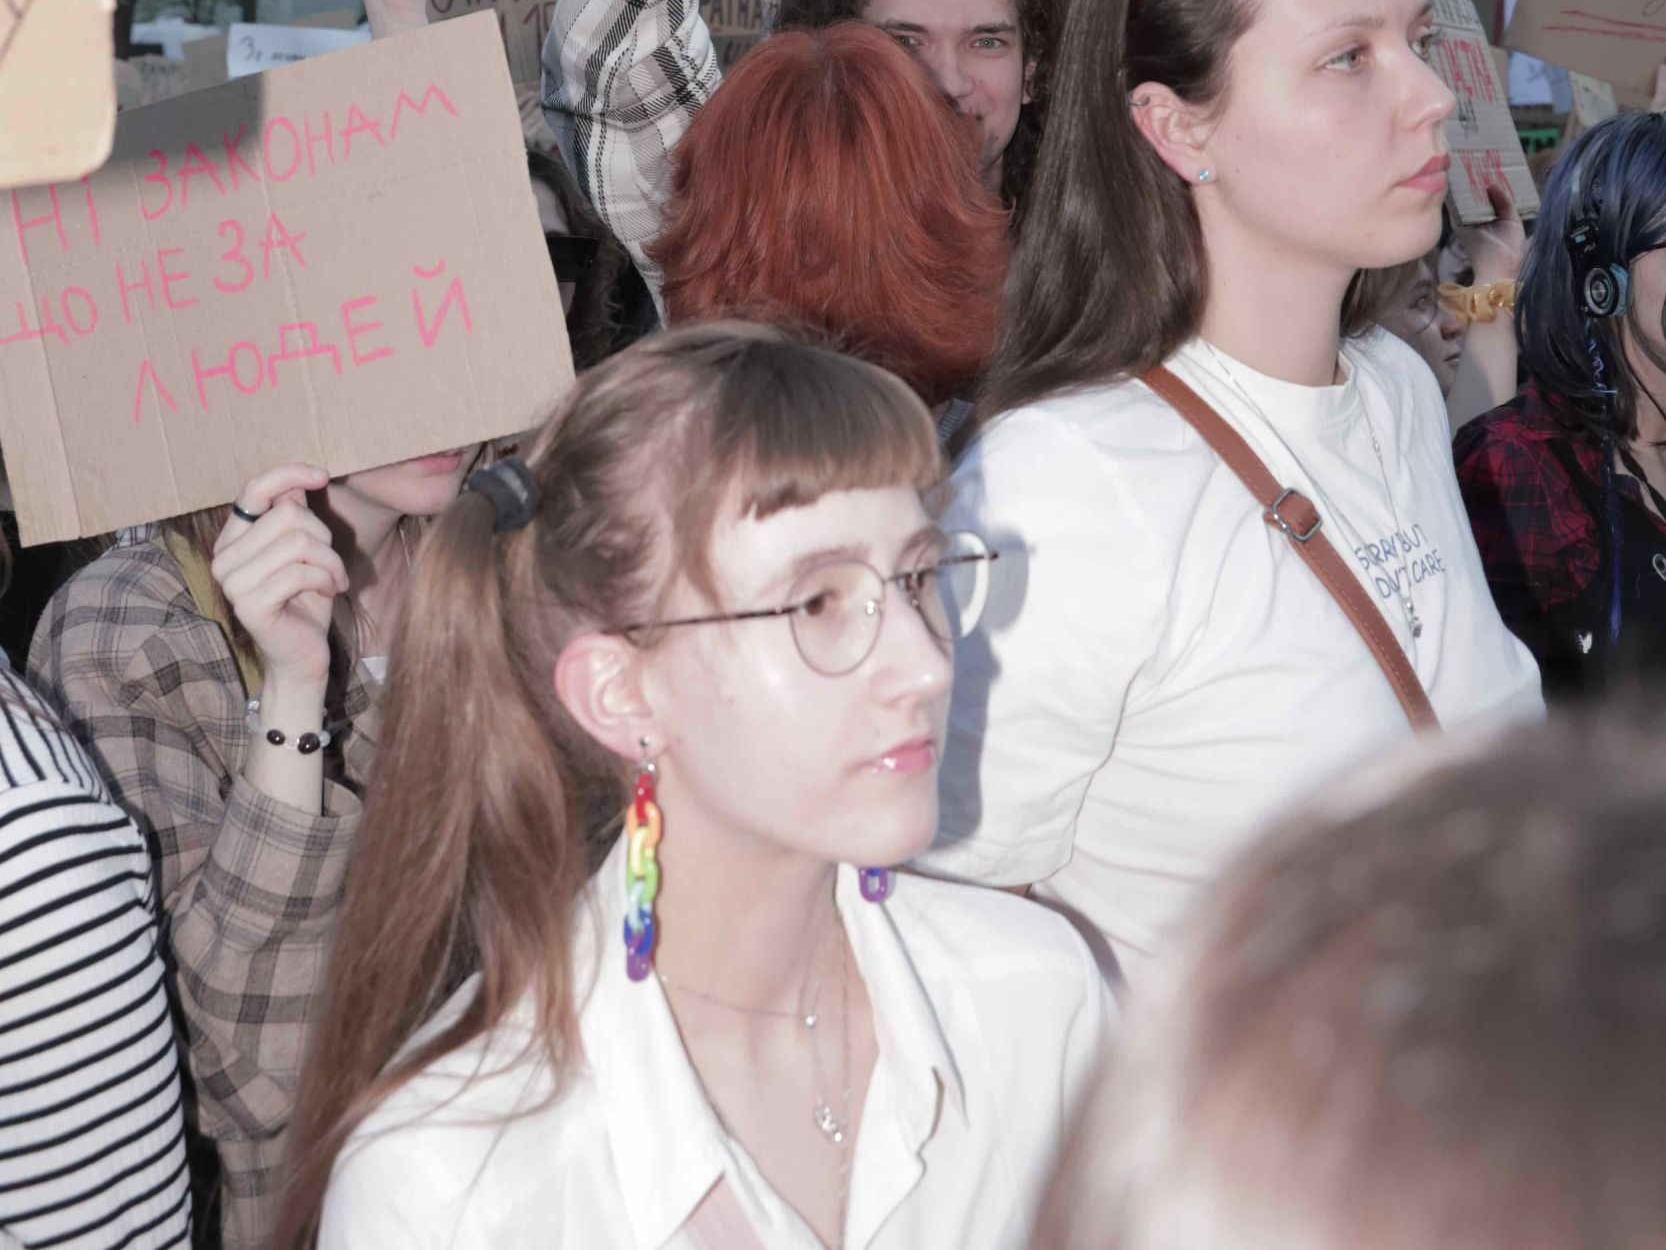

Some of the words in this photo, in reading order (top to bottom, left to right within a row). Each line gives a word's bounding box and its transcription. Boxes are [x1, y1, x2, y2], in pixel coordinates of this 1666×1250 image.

[9, 174, 102, 265] НІ
[139, 84, 459, 221] ЗАКОНАМ
[115, 247, 200, 324] НЕ
[212, 211, 308, 295] ЗА
[133, 257, 474, 426] ЛЮДЕЙ
[1411, 548, 1447, 584] CARE
